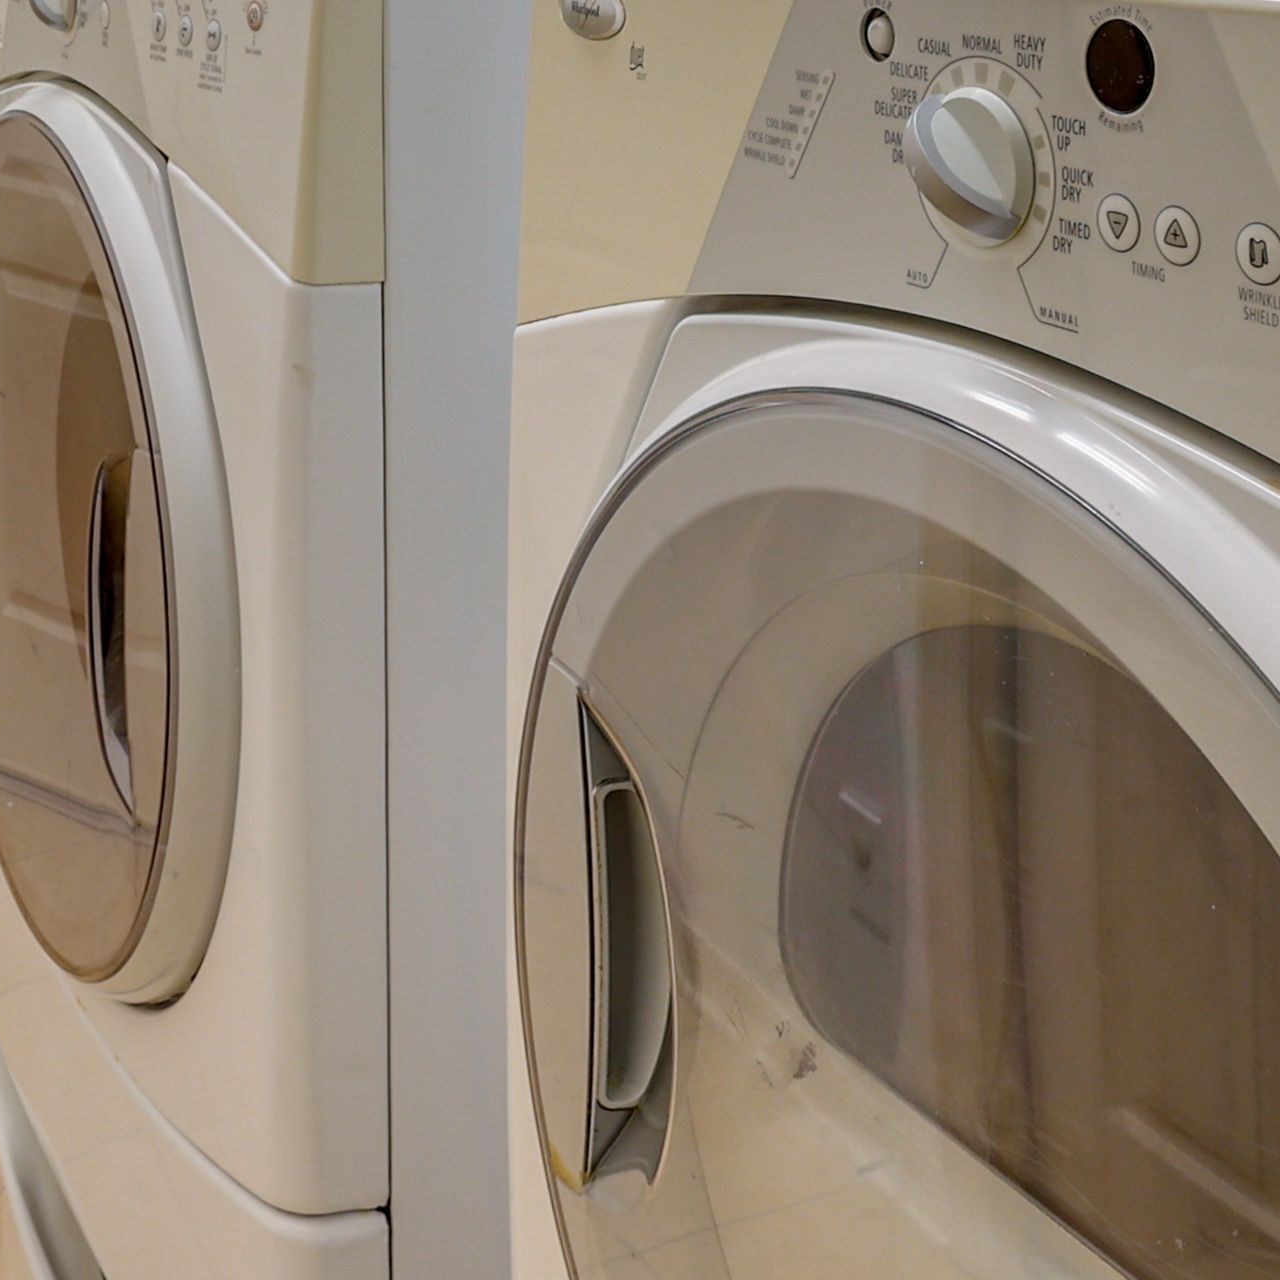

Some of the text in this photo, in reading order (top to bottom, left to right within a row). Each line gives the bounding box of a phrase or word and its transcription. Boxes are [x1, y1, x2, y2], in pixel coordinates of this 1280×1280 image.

[1089, 6, 1153, 32] Estimated Time
[918, 38, 951, 57] CASUAL
[962, 35, 1002, 54] NORMAL
[1014, 34, 1046, 52] HEAVY
[890, 61, 928, 81] DELICATE
[1016, 52, 1043, 70] DUTY
[891, 87, 918, 104] SUPER
[1052, 115, 1086, 135] TOUCH
[1098, 111, 1144, 133] Remaining
[1057, 135, 1071, 151] UP
[1061, 166, 1094, 187] QUICK
[1061, 185, 1082, 203] DRY
[1059, 218, 1091, 240] TIMED
[1053, 236, 1074, 254] DRY
[1131, 261, 1166, 282] TIMING
[1039, 306, 1079, 327] MANUAL
[1243, 305, 1280, 328] SHIELD
